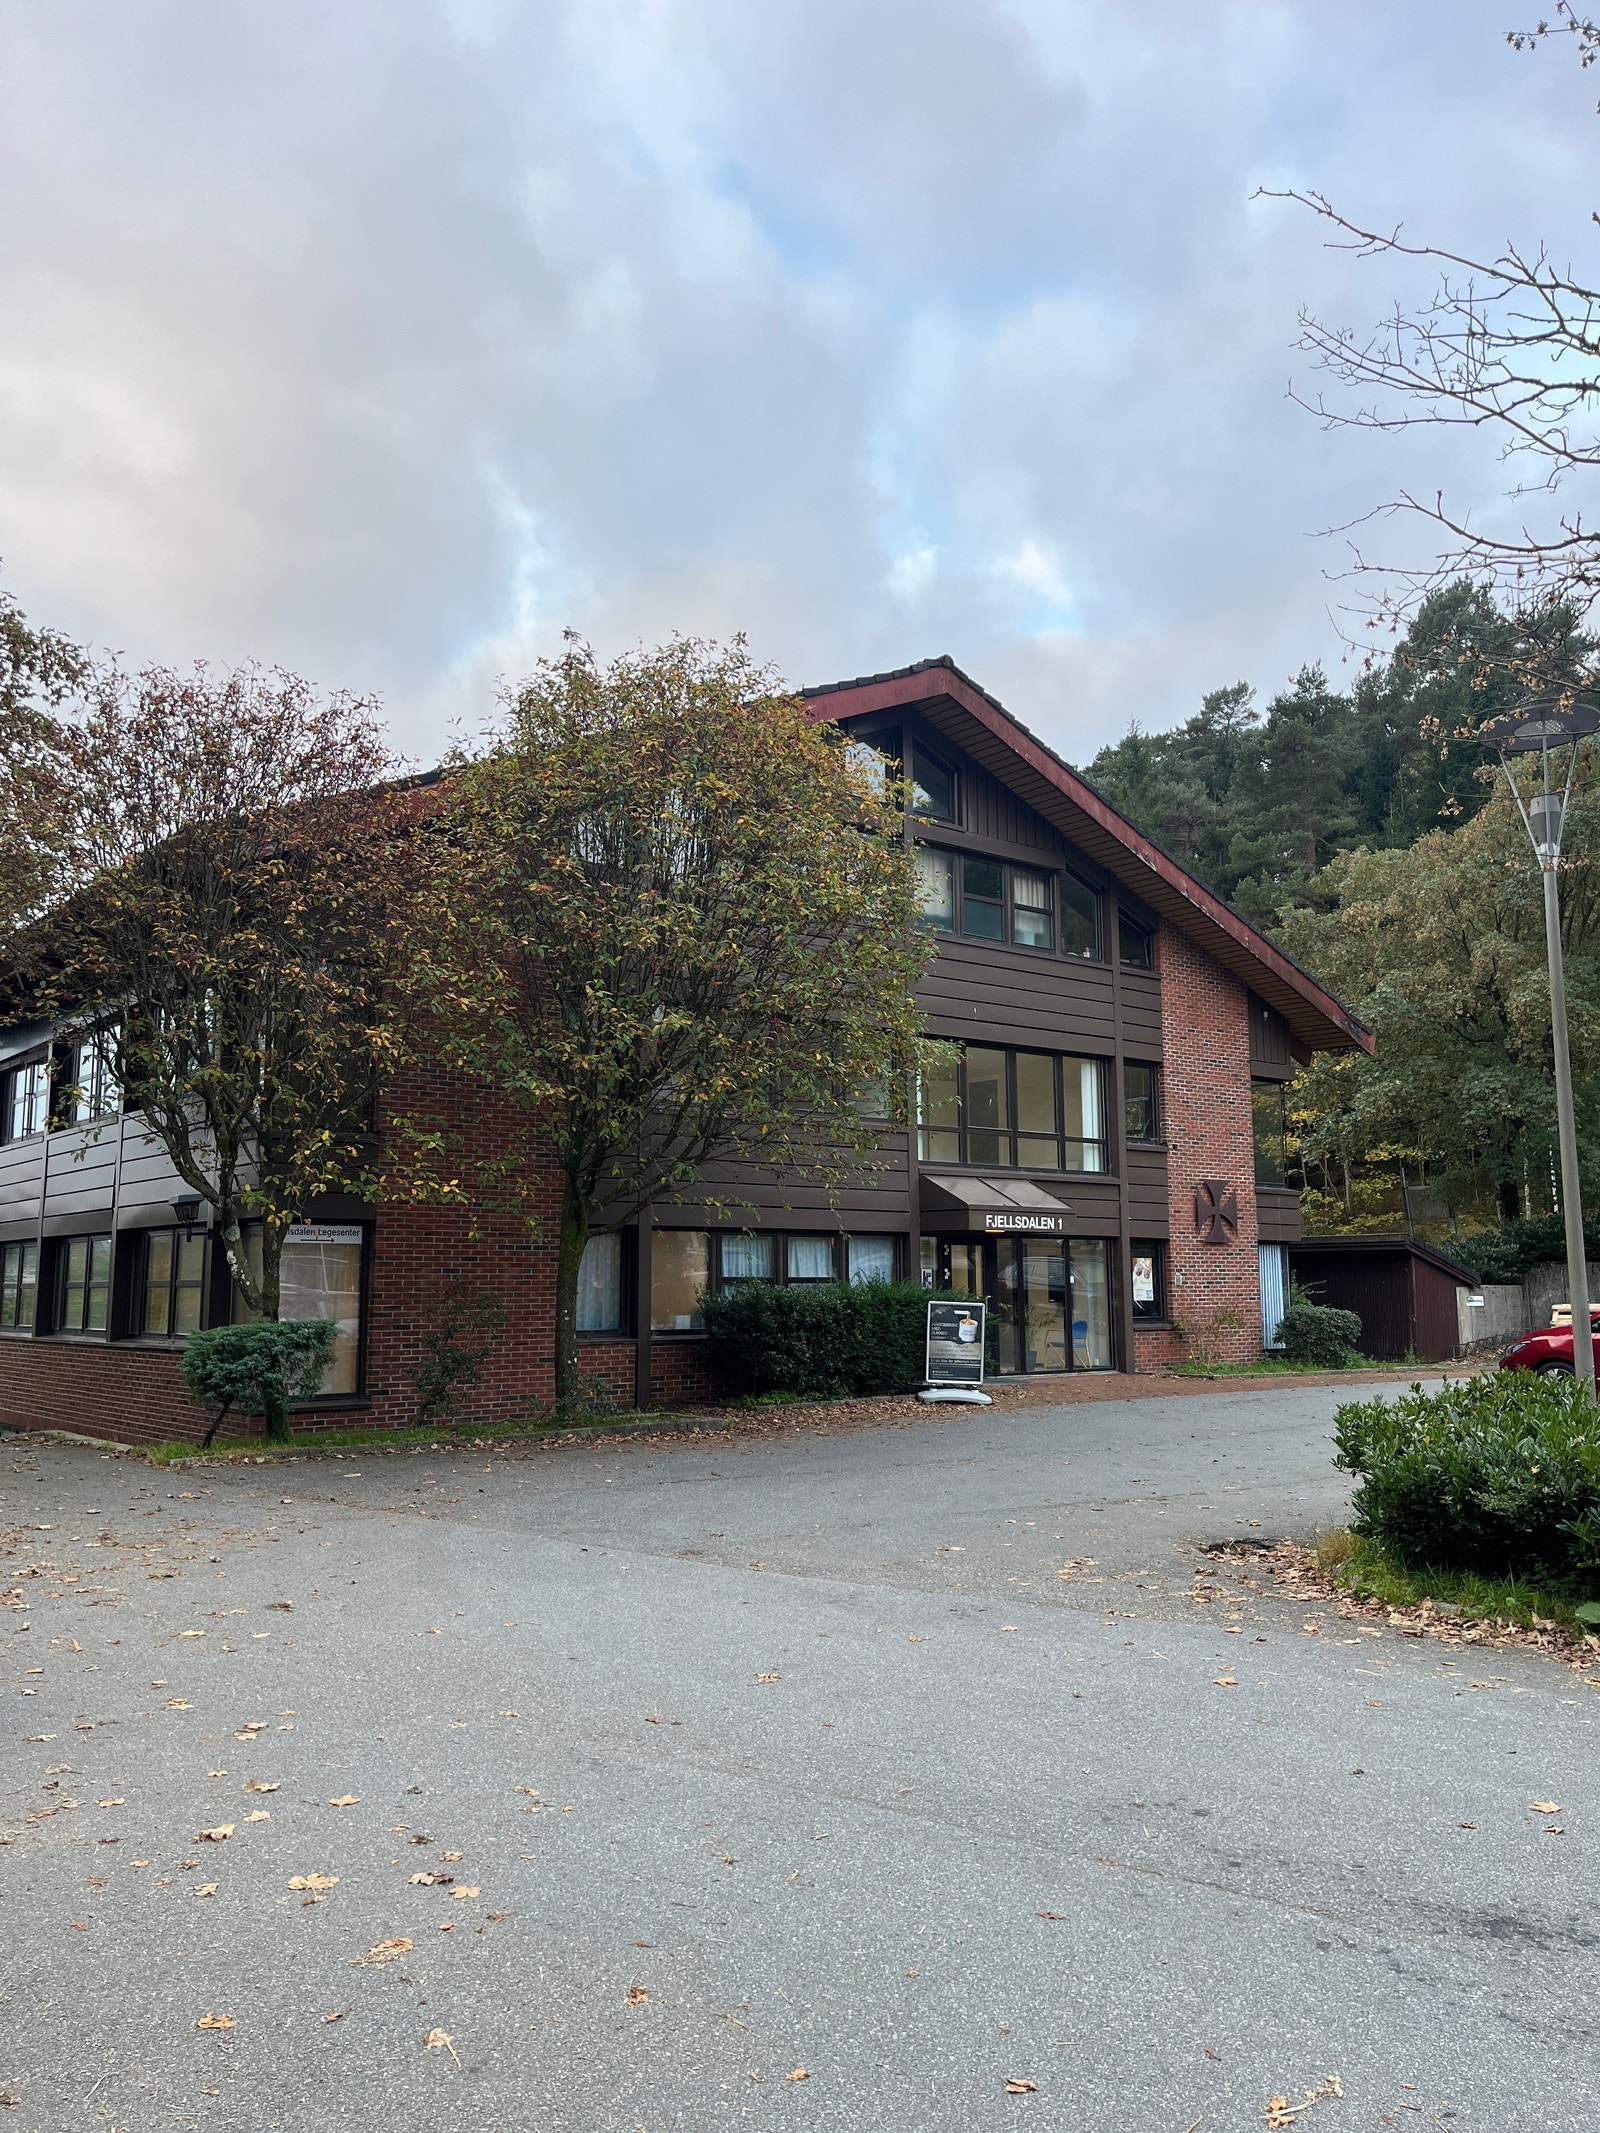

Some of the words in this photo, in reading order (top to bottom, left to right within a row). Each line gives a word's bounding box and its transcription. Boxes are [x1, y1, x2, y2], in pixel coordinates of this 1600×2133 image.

[985, 1215, 1055, 1230] FJELLSDALEN
[1057, 1217, 1063, 1230] 1
[318, 1228, 360, 1238] Legesenter
